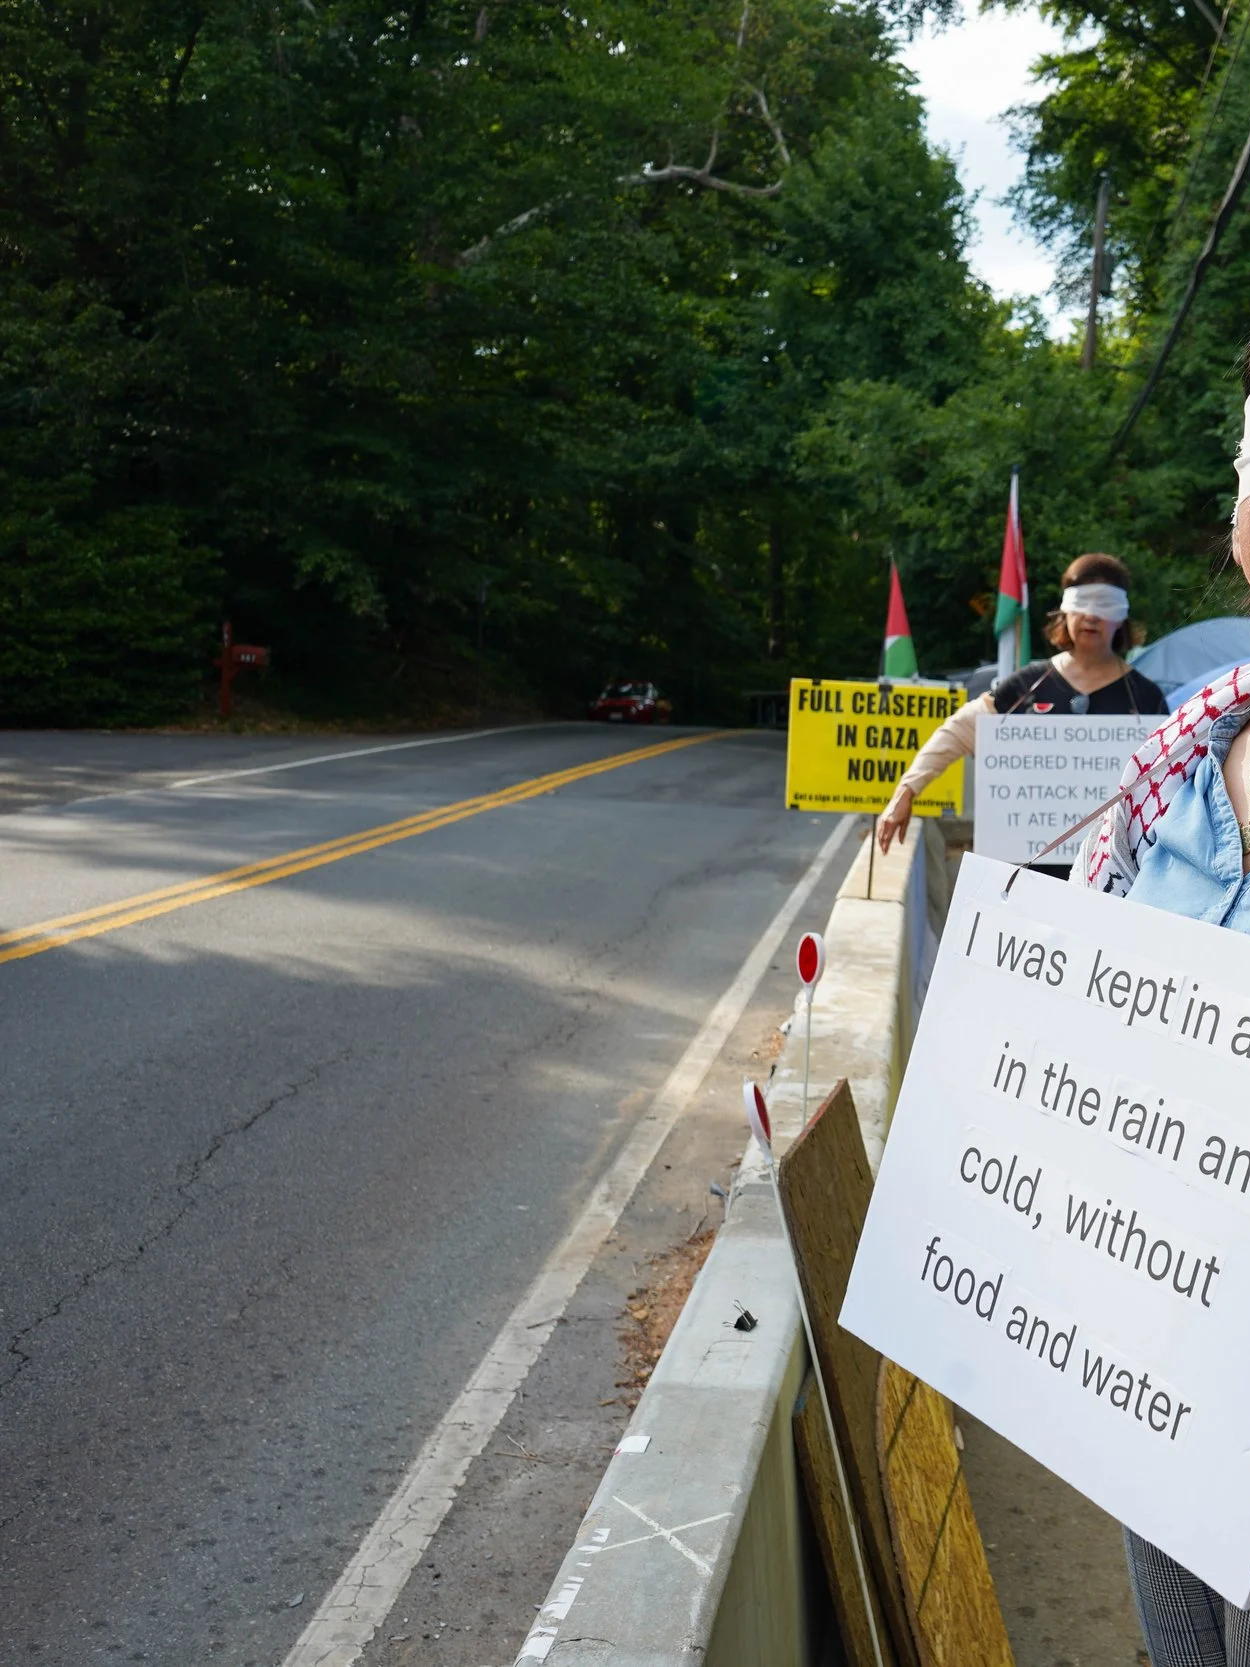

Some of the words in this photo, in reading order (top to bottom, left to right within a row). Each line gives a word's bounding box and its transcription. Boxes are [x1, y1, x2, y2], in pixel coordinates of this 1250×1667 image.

[798, 688, 844, 713] FULL
[852, 691, 960, 719] CEASEFIRE
[837, 724, 857, 748] IN
[866, 726, 919, 750] GAZA
[995, 727, 1057, 741] ISRAELI
[1064, 727, 1148, 742] SOLDIERS
[984, 755, 1067, 770] ORDERED
[1072, 756, 1121, 771] THEIR
[989, 785, 1011, 800] TO
[1017, 785, 1078, 800] ATTACK
[1084, 786, 1109, 801] ME
[1008, 813, 1021, 827] IT
[1028, 813, 1057, 827] ATE
[966, 911, 980, 956] I
[997, 931, 1067, 986] was
[1087, 950, 1177, 1026] kept
[1181, 983, 1221, 1045] in
[993, 1041, 1026, 1099] in
[1041, 1063, 1100, 1126] the
[1108, 1096, 1185, 1161] rain
[960, 1147, 1043, 1230] cold,
[1065, 1195, 1221, 1308] without
[921, 1237, 1004, 1322] food
[1005, 1306, 1077, 1372] and
[1082, 1349, 1191, 1441] water
